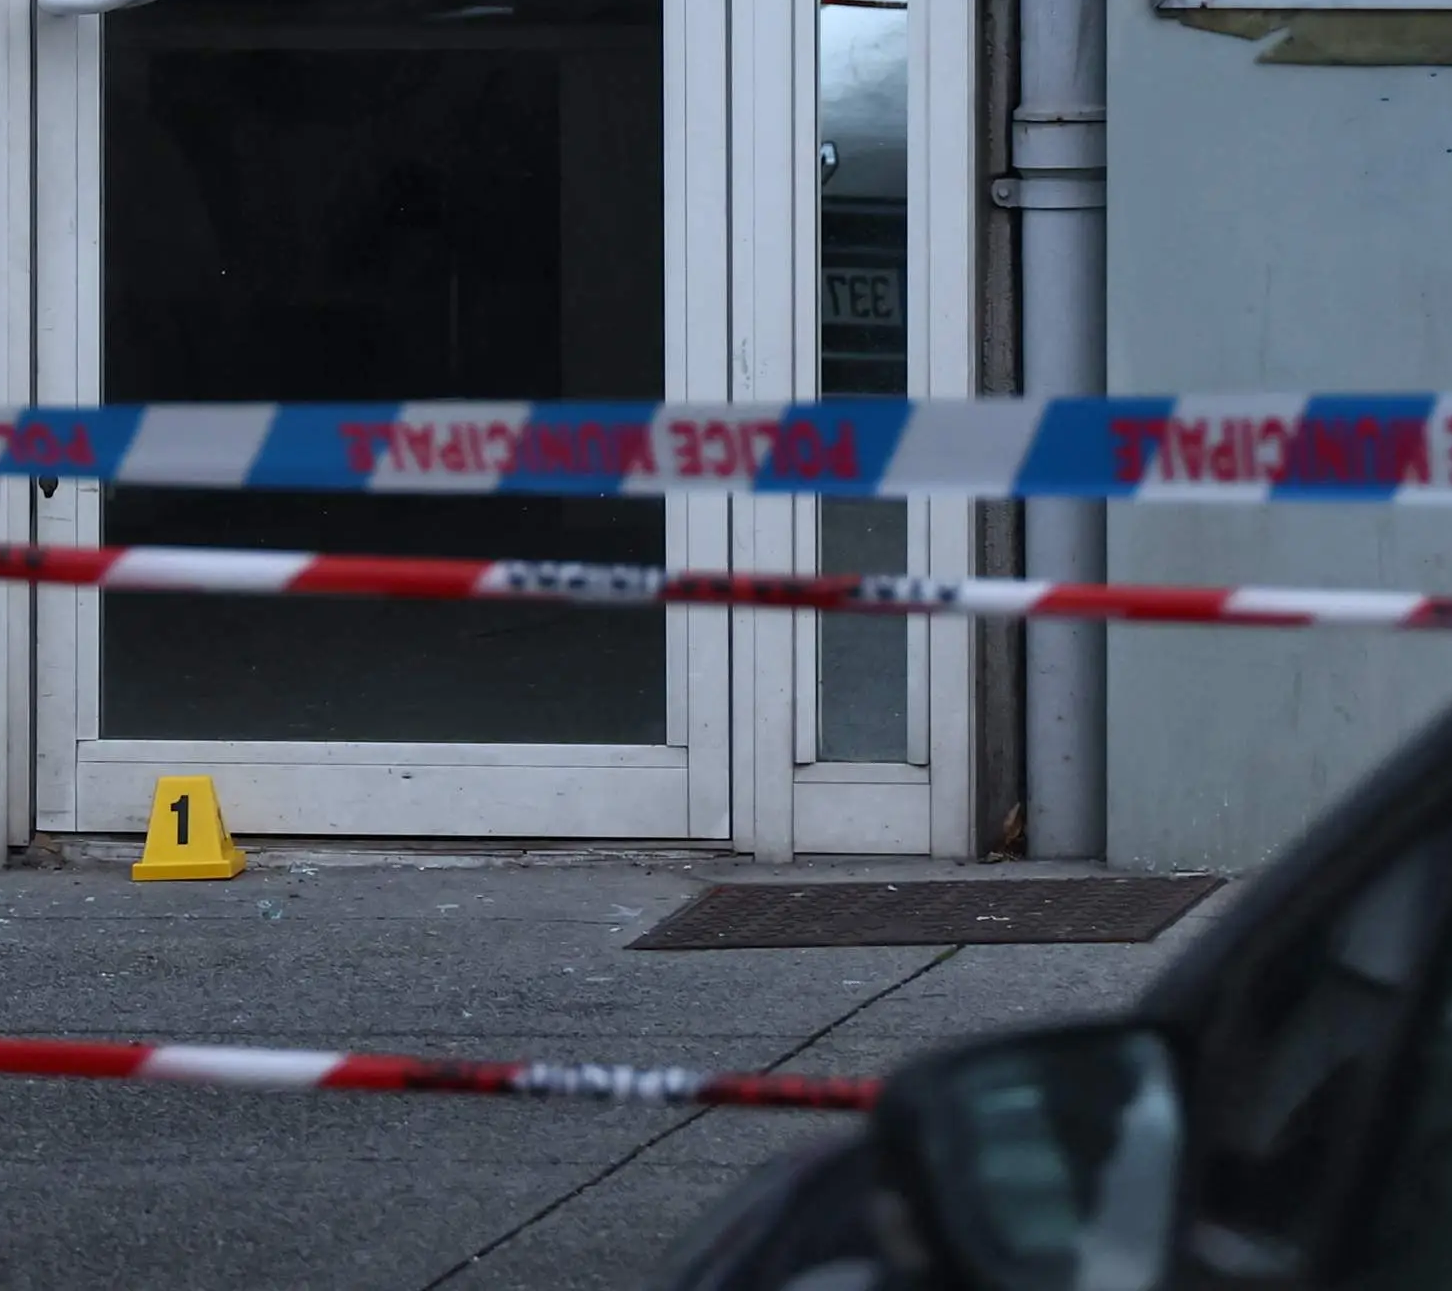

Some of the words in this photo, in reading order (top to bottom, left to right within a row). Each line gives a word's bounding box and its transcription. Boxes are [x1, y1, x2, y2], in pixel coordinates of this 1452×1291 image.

[338, 420, 656, 477] MUNICIPALE
[667, 419, 862, 481] POLICE
[1108, 415, 1433, 485] MUNICIPALE
[170, 794, 189, 845] 1
